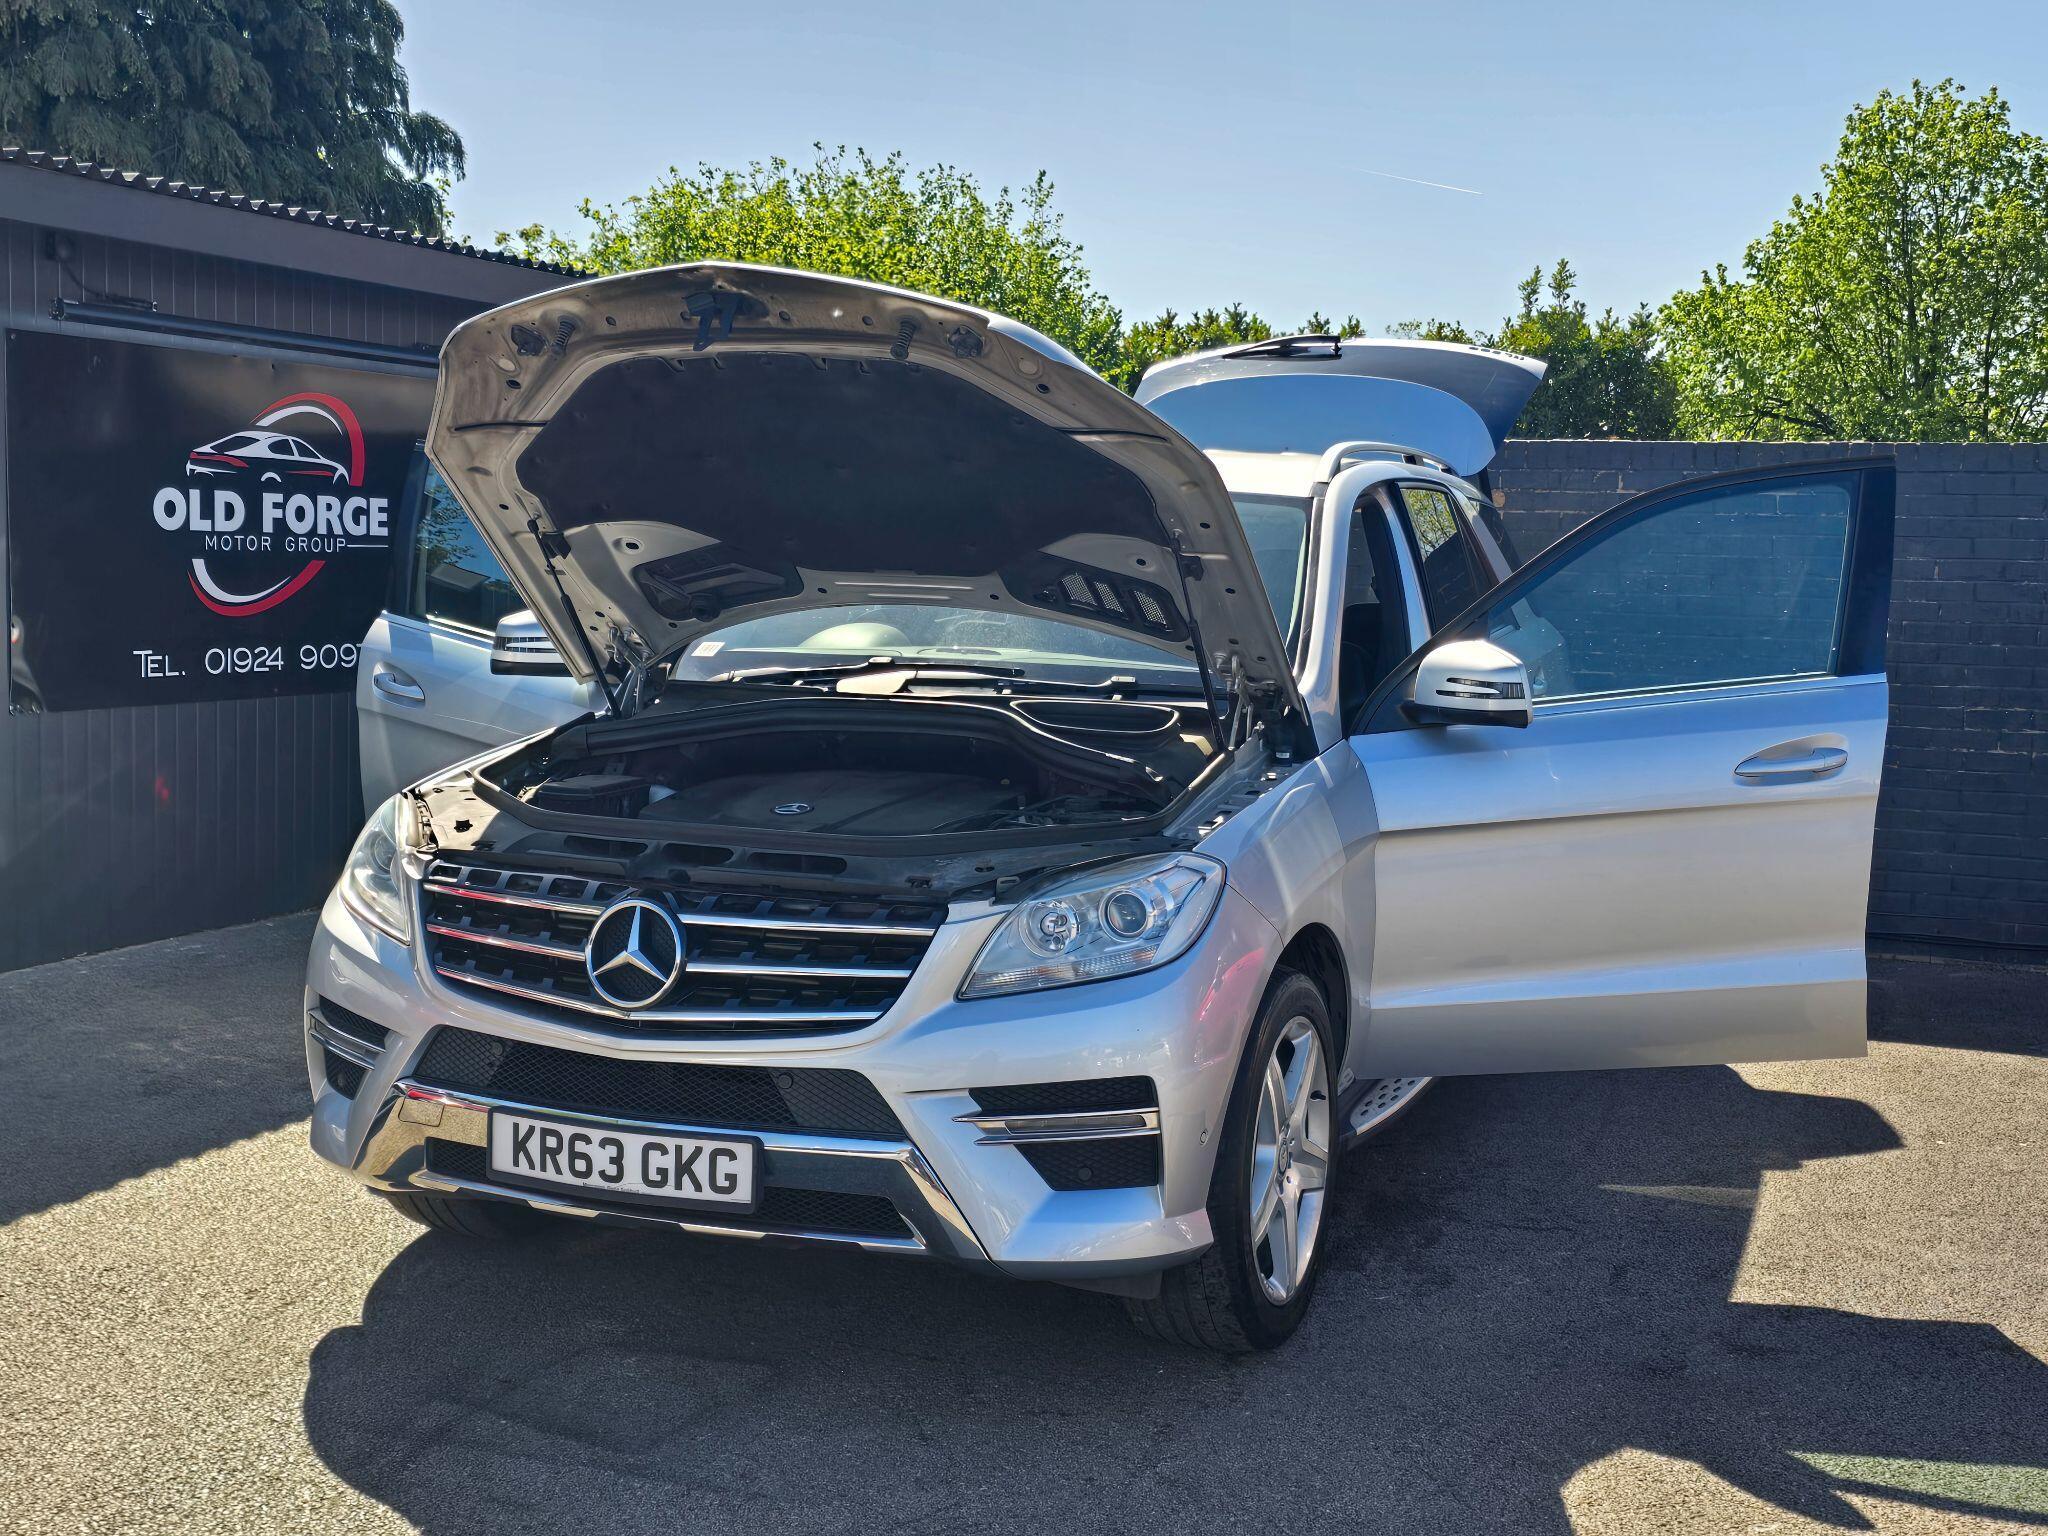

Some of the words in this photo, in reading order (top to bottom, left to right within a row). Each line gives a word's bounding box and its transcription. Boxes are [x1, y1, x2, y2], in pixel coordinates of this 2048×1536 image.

[153, 487, 245, 532] OLD
[262, 493, 389, 537] FORGE
[205, 535, 271, 552] MOTOR
[285, 537, 346, 553] GROUP
[205, 646, 284, 675] 01924
[300, 643, 361, 670] 909
[512, 1122, 625, 1184] KR63
[641, 1142, 738, 1194] GKG
